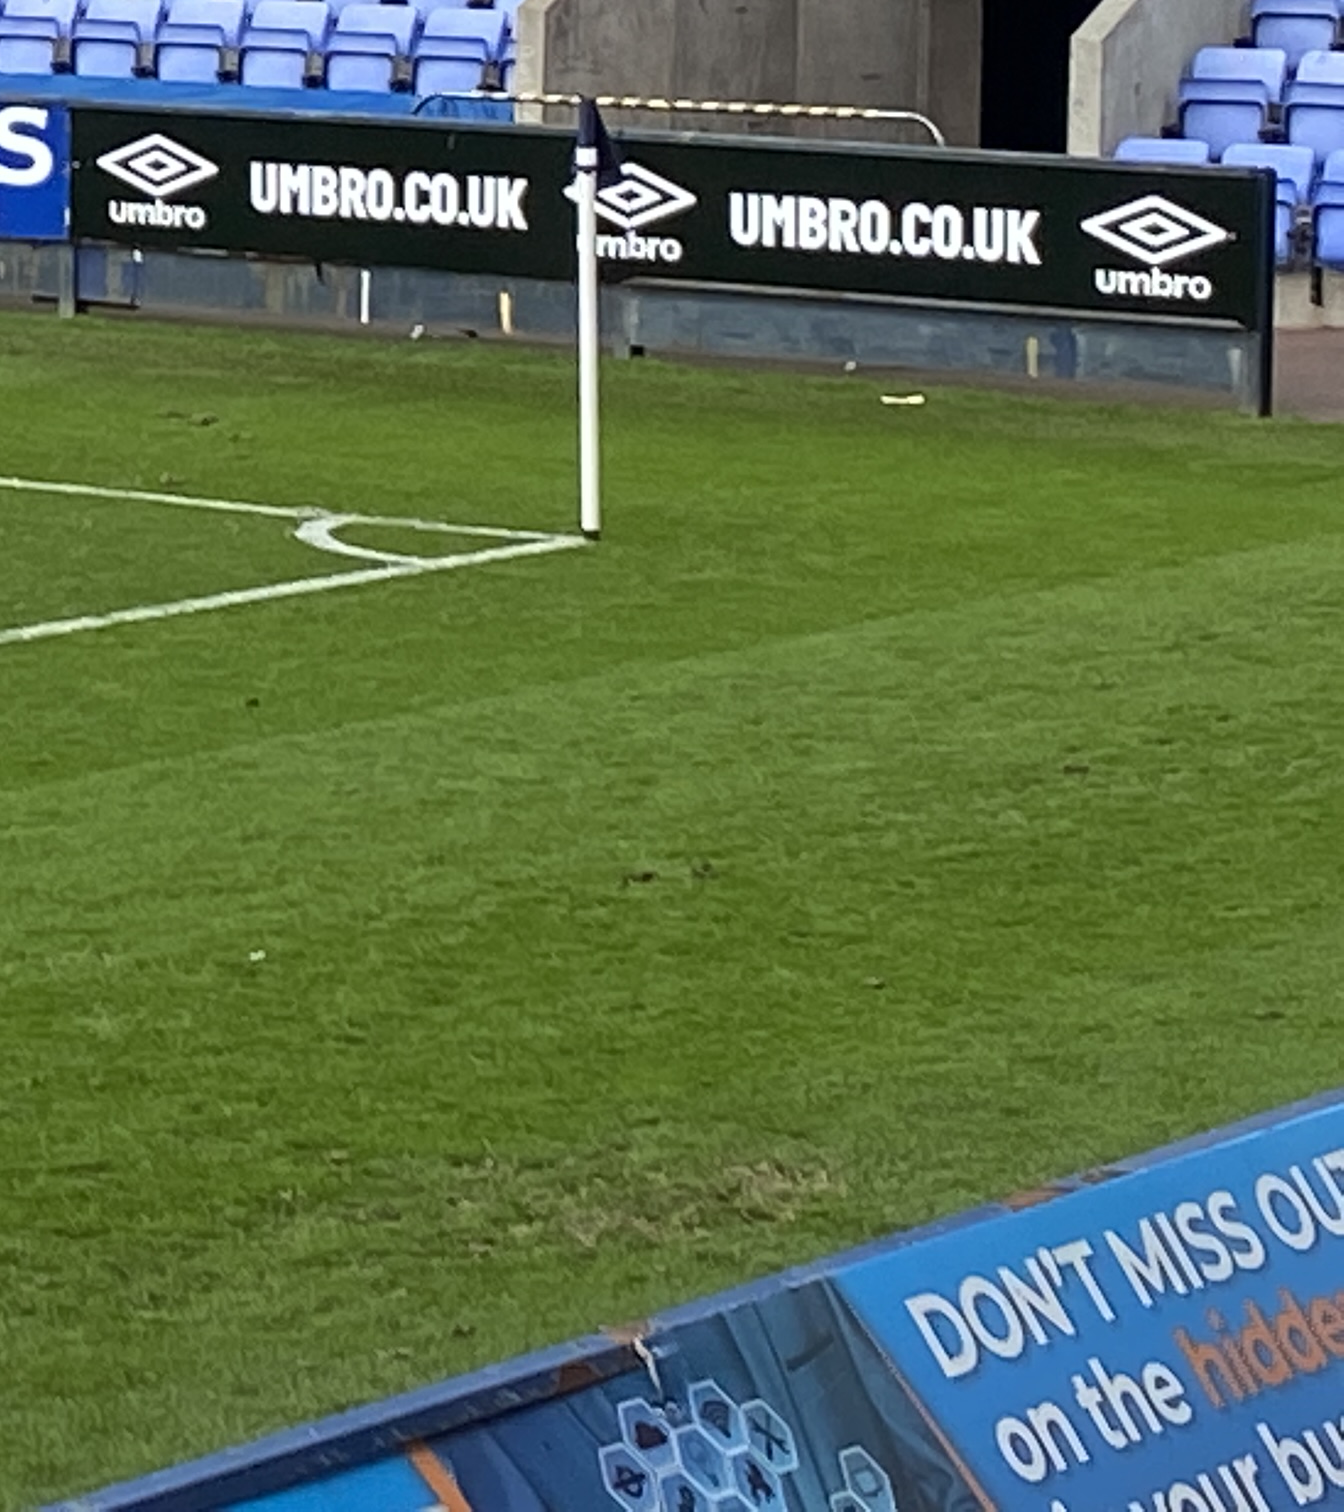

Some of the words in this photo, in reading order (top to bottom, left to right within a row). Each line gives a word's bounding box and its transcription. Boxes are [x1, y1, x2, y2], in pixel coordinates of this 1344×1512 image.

[107, 197, 206, 231] umbro
[248, 159, 530, 231] UMBRO.CO.UK
[728, 189, 1042, 267] UMBRO.CO.UK
[576, 229, 683, 263] mbro
[1095, 265, 1212, 301] umbro
[903, 1238, 1117, 1380] DON'T
[1102, 1190, 1267, 1310] MISS
[994, 1400, 1091, 1483] on
[1070, 1357, 1193, 1450] the
